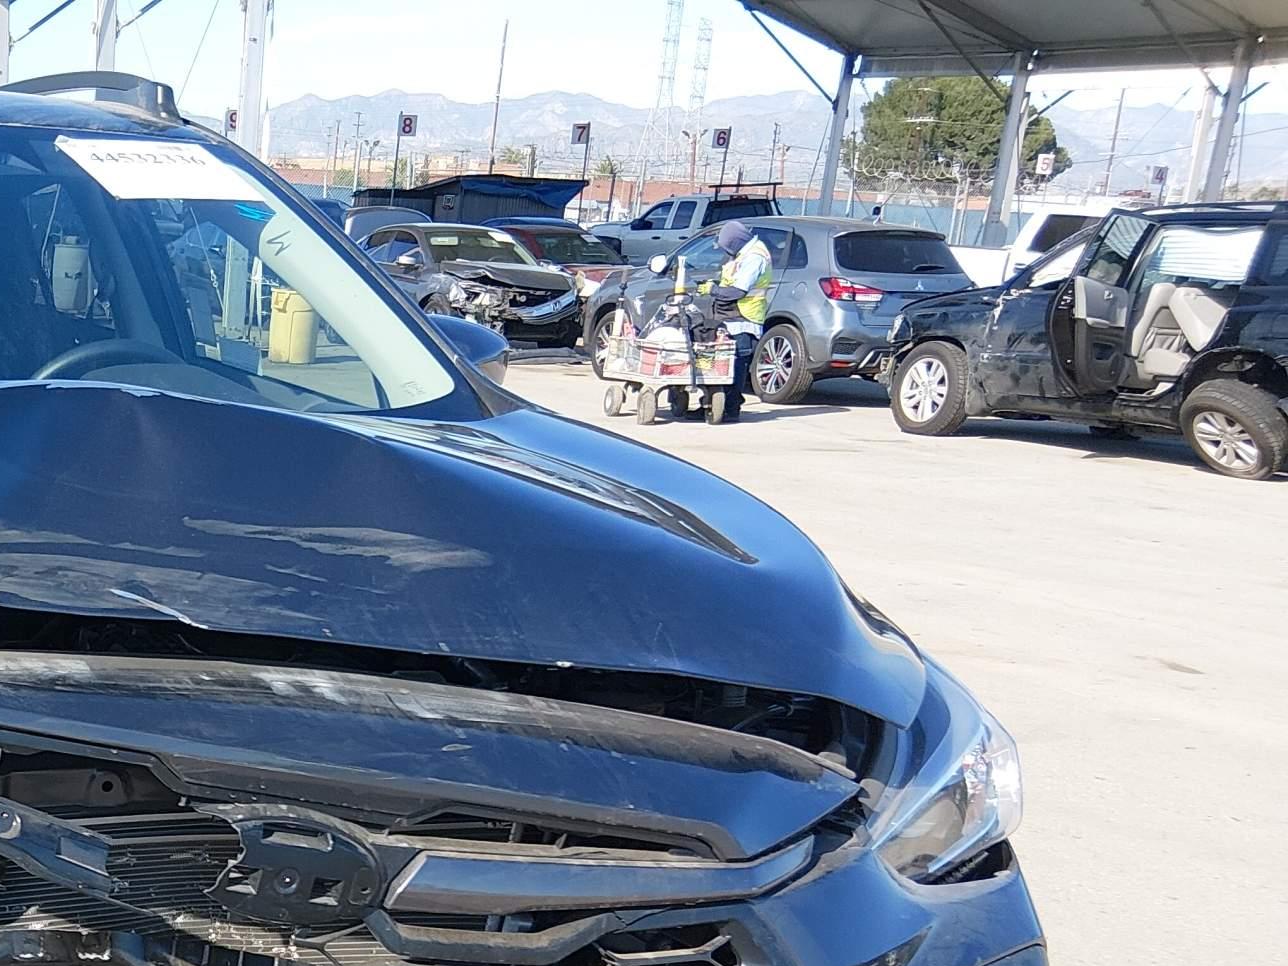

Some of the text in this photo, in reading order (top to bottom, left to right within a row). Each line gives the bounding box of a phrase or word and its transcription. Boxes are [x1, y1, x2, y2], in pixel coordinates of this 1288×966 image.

[402, 117, 412, 134] 8
[575, 125, 586, 142] 7
[716, 131, 727, 146] 6
[90, 152, 206, 165] 44532336
[1040, 157, 1050, 171] 5
[1155, 168, 1164, 183] 4
